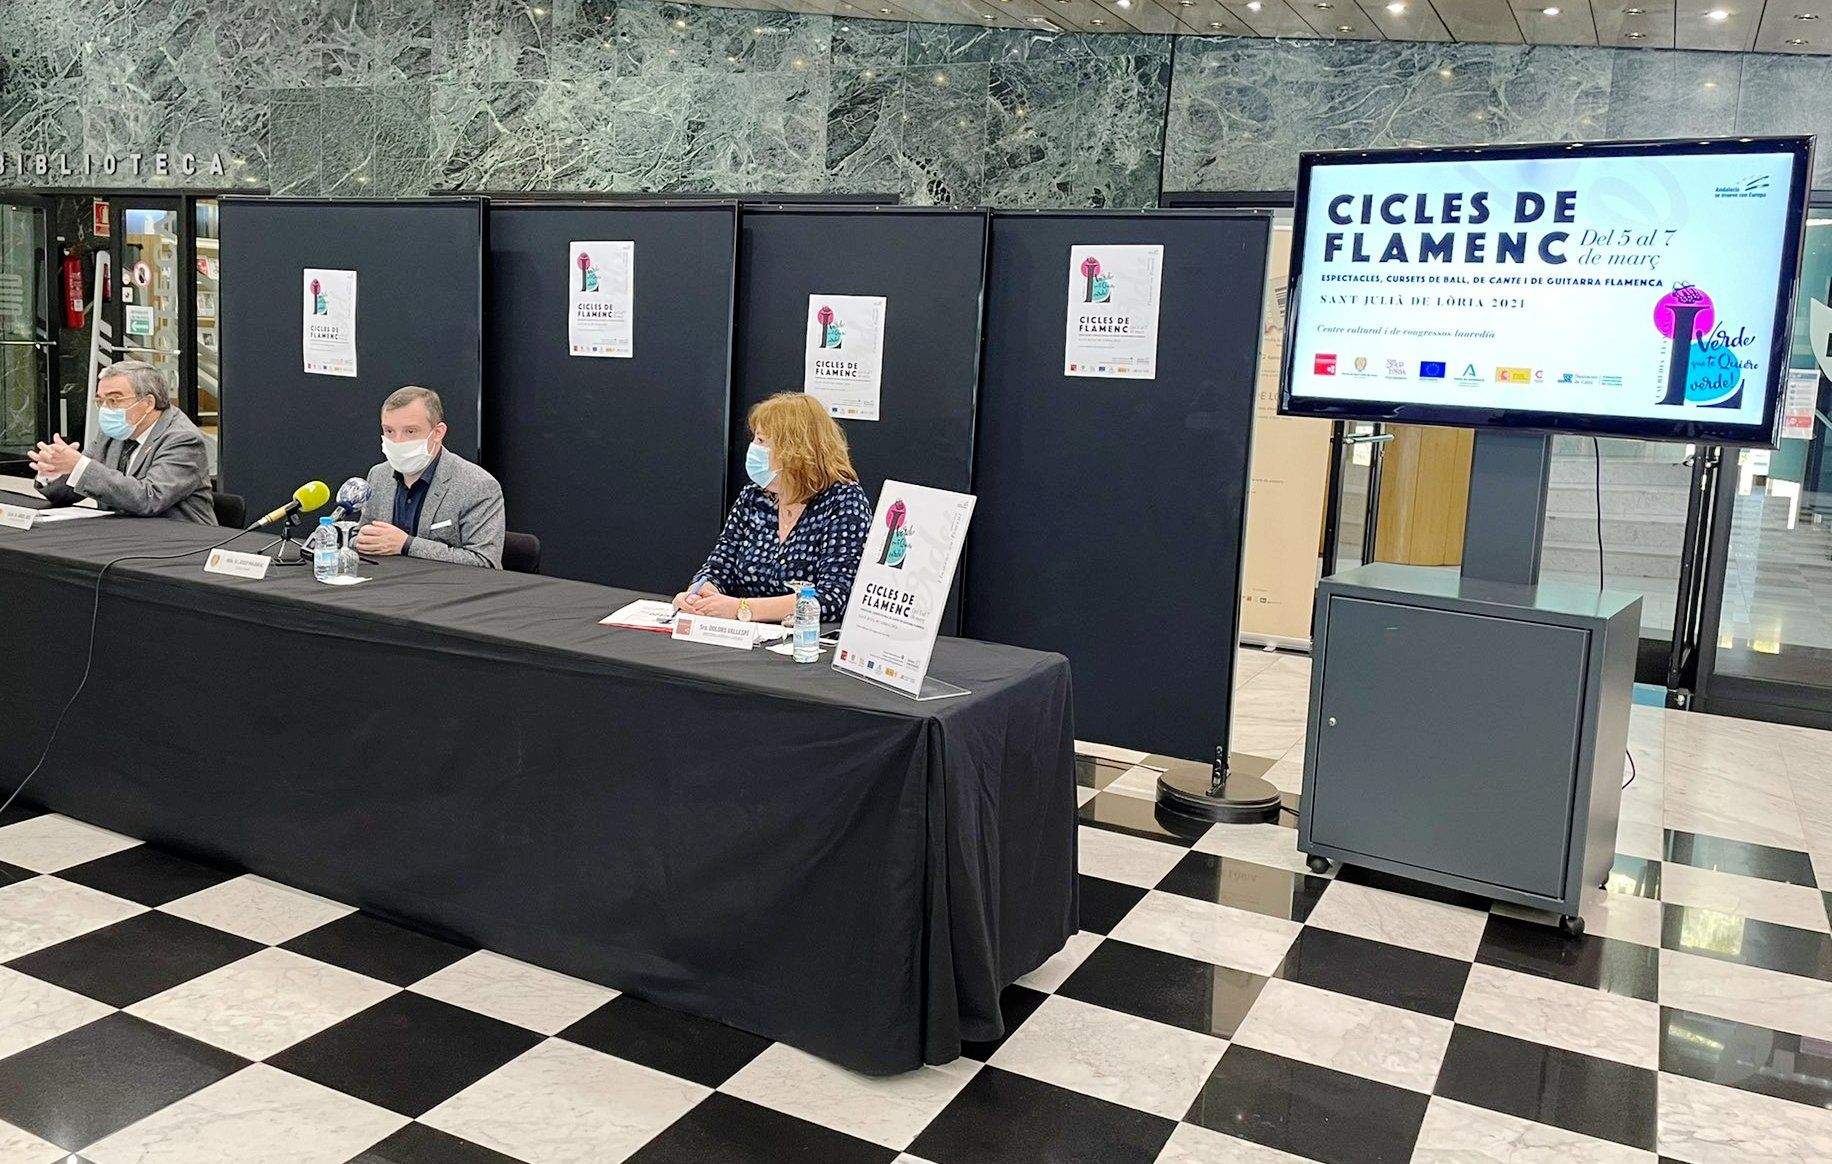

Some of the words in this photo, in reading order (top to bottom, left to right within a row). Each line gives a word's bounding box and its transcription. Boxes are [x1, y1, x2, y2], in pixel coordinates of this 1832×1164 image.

[1328, 191, 1491, 225] CICLES
[1513, 190, 1578, 224] DE
[1579, 228, 1615, 247] Del
[1617, 229, 1632, 247] 5
[1635, 228, 1658, 247] al
[1663, 229, 1679, 247] 7
[1324, 231, 1571, 265] FLAMENC
[1577, 248, 1602, 266] de
[1607, 252, 1661, 271] març
[1320, 274, 1384, 284] ESPECTACLES,
[1386, 275, 1426, 283] CURSETS
[1428, 276, 1441, 284] DE
[1443, 276, 1471, 285] BALL,
[1473, 276, 1486, 284] DE
[1489, 276, 1521, 285] CANTE
[1530, 277, 1544, 285] DE
[1547, 277, 1602, 286] GUITARRA
[1604, 278, 1664, 288] FLAMENCA
[577, 303, 602, 311] CICLES
[604, 303, 614, 311] DE
[1320, 294, 1358, 306] SANT
[1411, 296, 1431, 307] DE
[1491, 298, 1526, 308] 2021
[577, 310, 613, 319] FLAMENC
[1079, 316, 1114, 325] CICLES
[1117, 316, 1130, 325] DE
[310, 325, 331, 333] CICLES
[310, 332, 338, 340] FLAMENC
[1079, 325, 1129, 334] FLAMENC
[1316, 324, 1346, 334] Centre
[1346, 325, 1383, 336] cultural
[1389, 326, 1401, 336] de
[1402, 329, 1452, 339] congressos
[1695, 320, 1757, 353] Verde
[815, 360, 845, 369] CICLES
[847, 362, 858, 370] DE
[1706, 355, 1716, 367] te
[1717, 352, 1760, 370] Quiere
[815, 368, 858, 378] FLAMENC
[1689, 373, 1735, 392] verde!
[866, 583, 899, 601] CICLES
[901, 593, 915, 606] DE
[861, 594, 911, 618] FLAMENC
